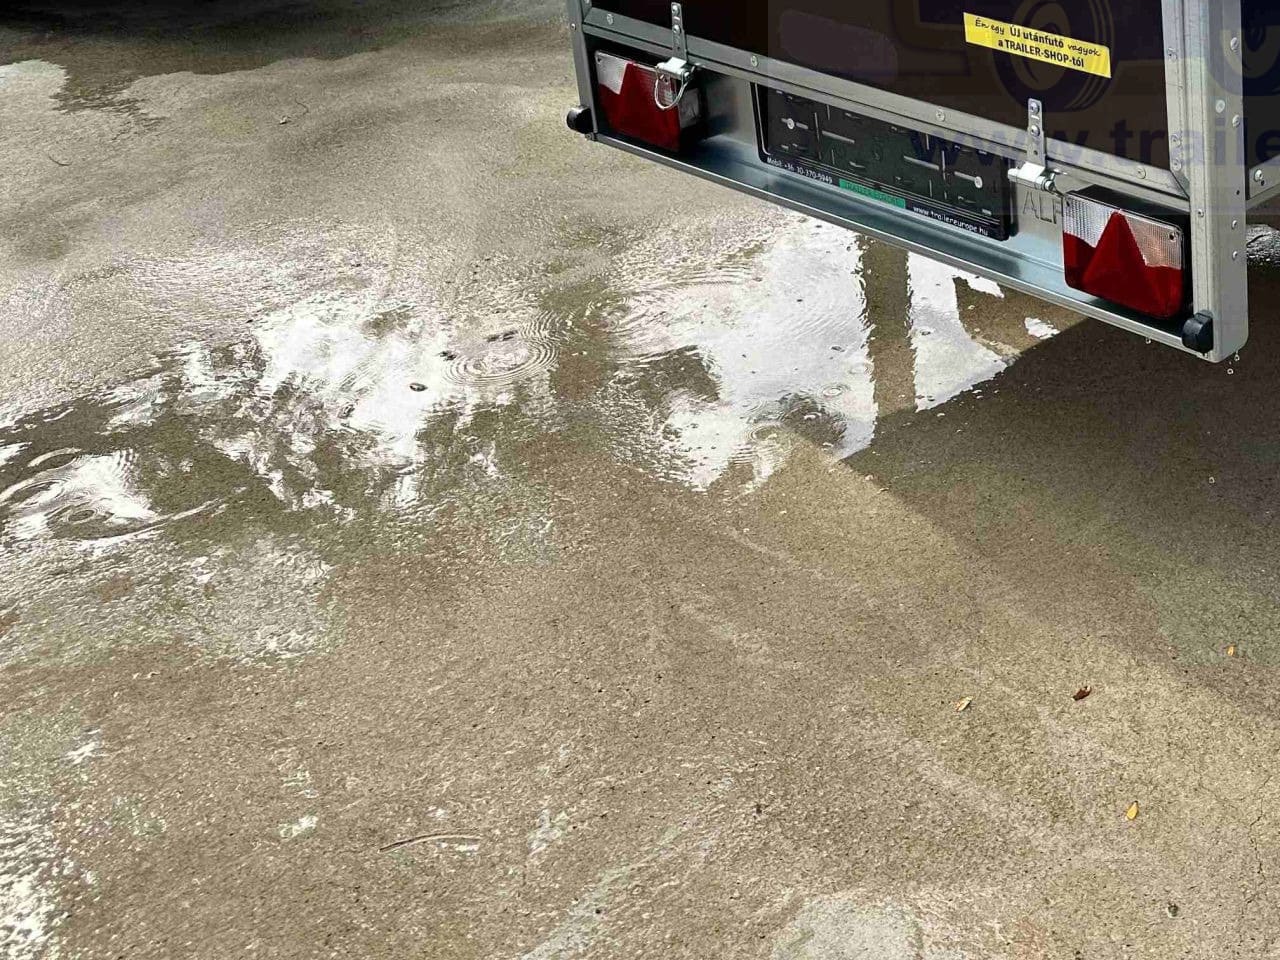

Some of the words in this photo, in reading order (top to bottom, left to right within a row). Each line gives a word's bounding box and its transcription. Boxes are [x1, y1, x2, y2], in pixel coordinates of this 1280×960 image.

[975, 17, 989, 29] Én
[990, 24, 1005, 36] egy
[1009, 24, 1021, 37] ÚJ
[1022, 29, 1064, 48] utánfutó
[1067, 43, 1101, 57] vagyok
[997, 39, 1004, 48] a
[1005, 39, 1084, 68] TRAILER-SHOP-tól
